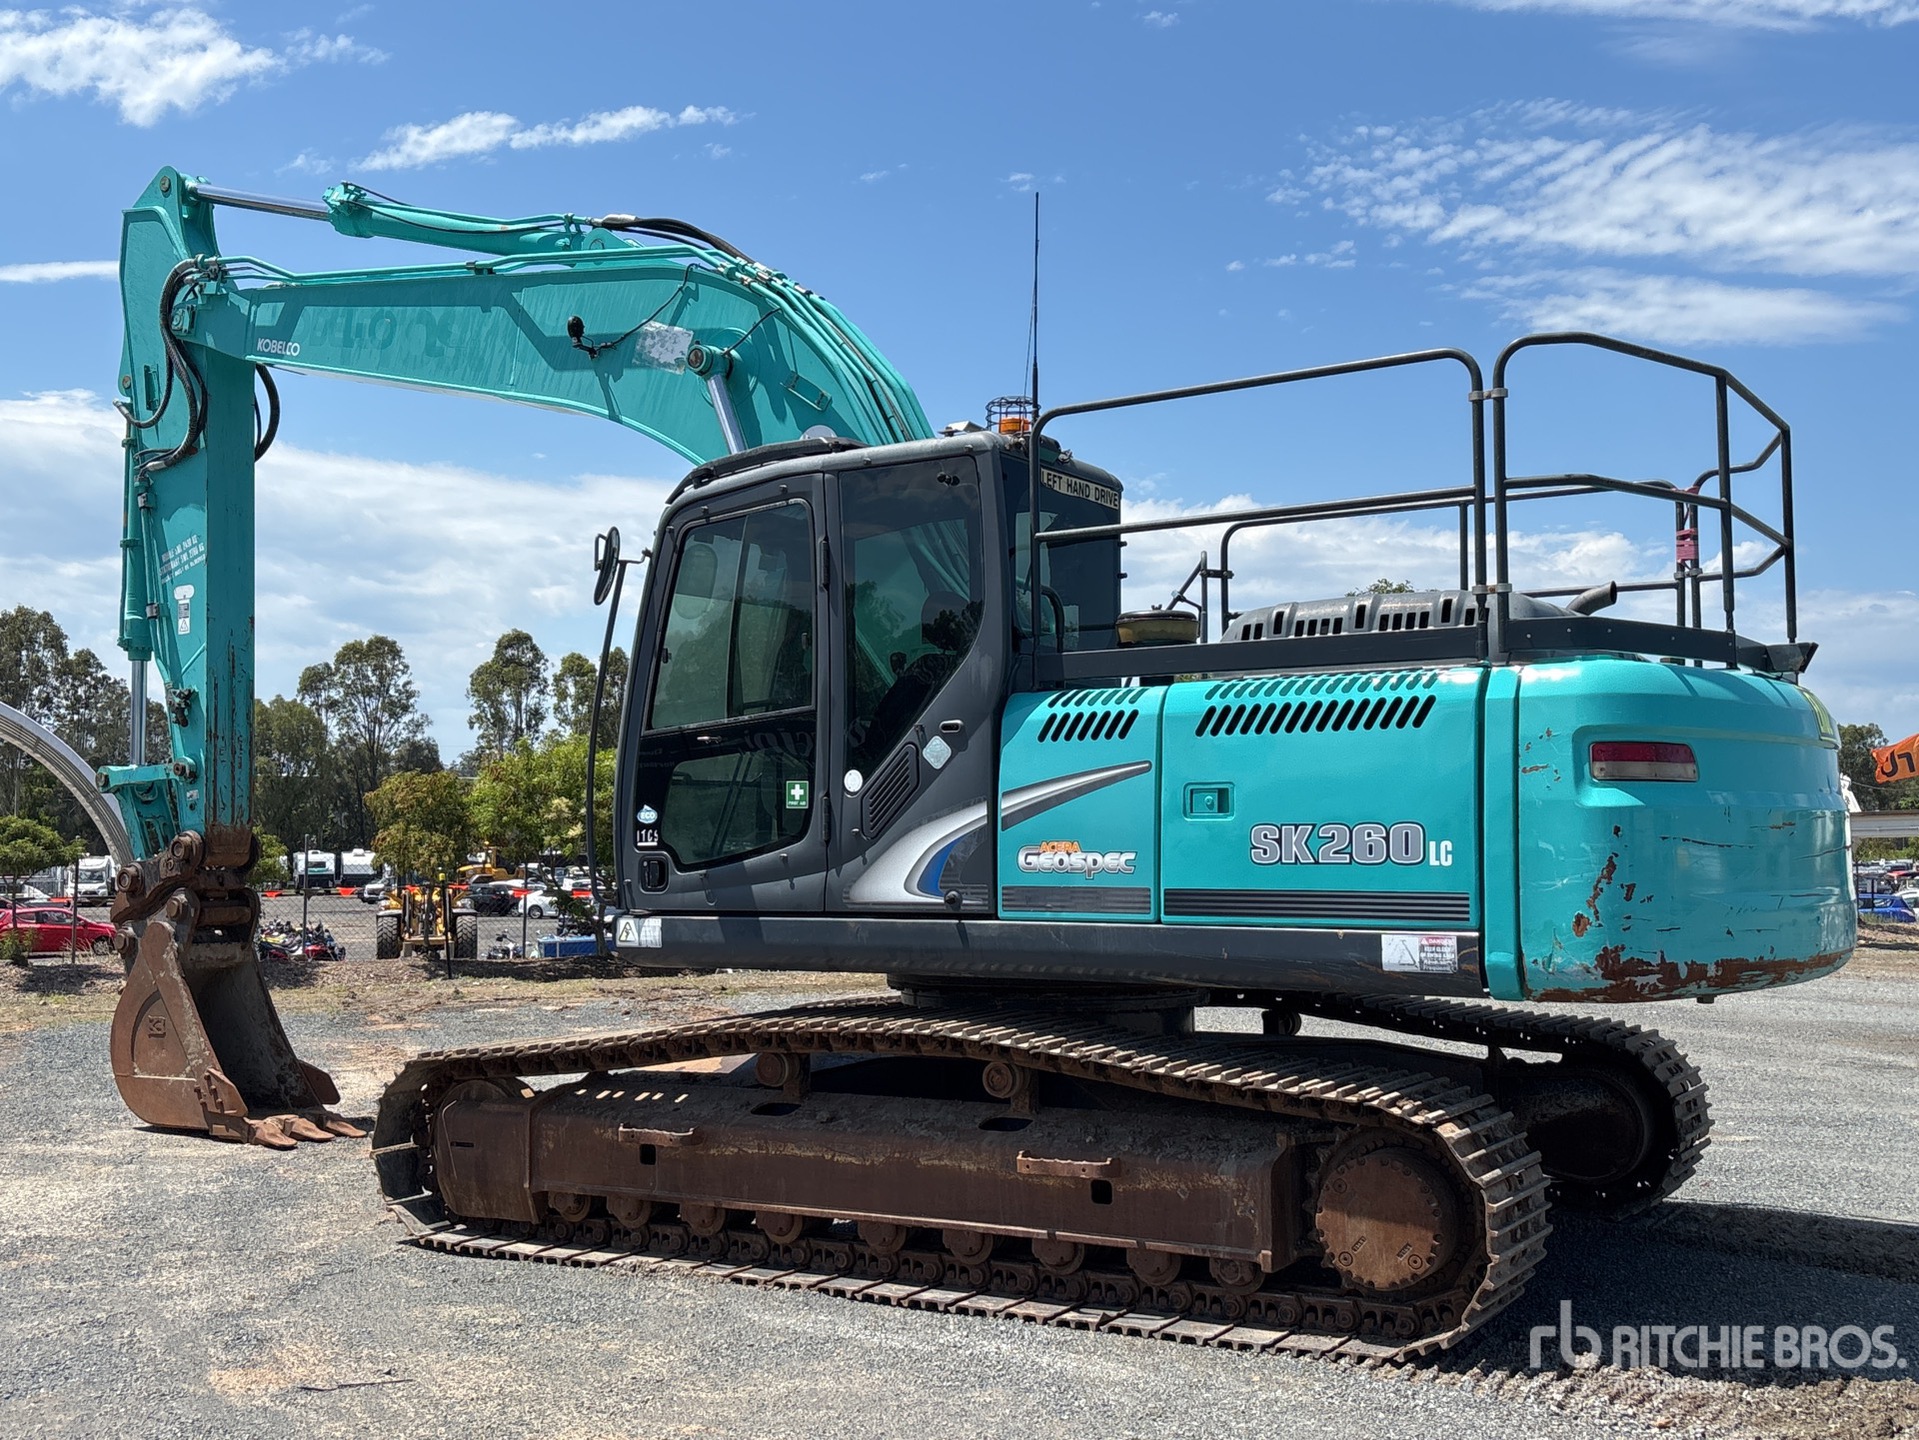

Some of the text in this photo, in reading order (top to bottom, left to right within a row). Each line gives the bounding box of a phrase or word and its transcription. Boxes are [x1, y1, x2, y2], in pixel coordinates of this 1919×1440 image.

[257, 338, 300, 357] KOBELCO
[1041, 471, 1118, 507] LEFT HAND DRIVE
[640, 811, 656, 820] ECO
[1040, 841, 1080, 853] ACERA
[1250, 822, 1453, 866] SK260 LC
